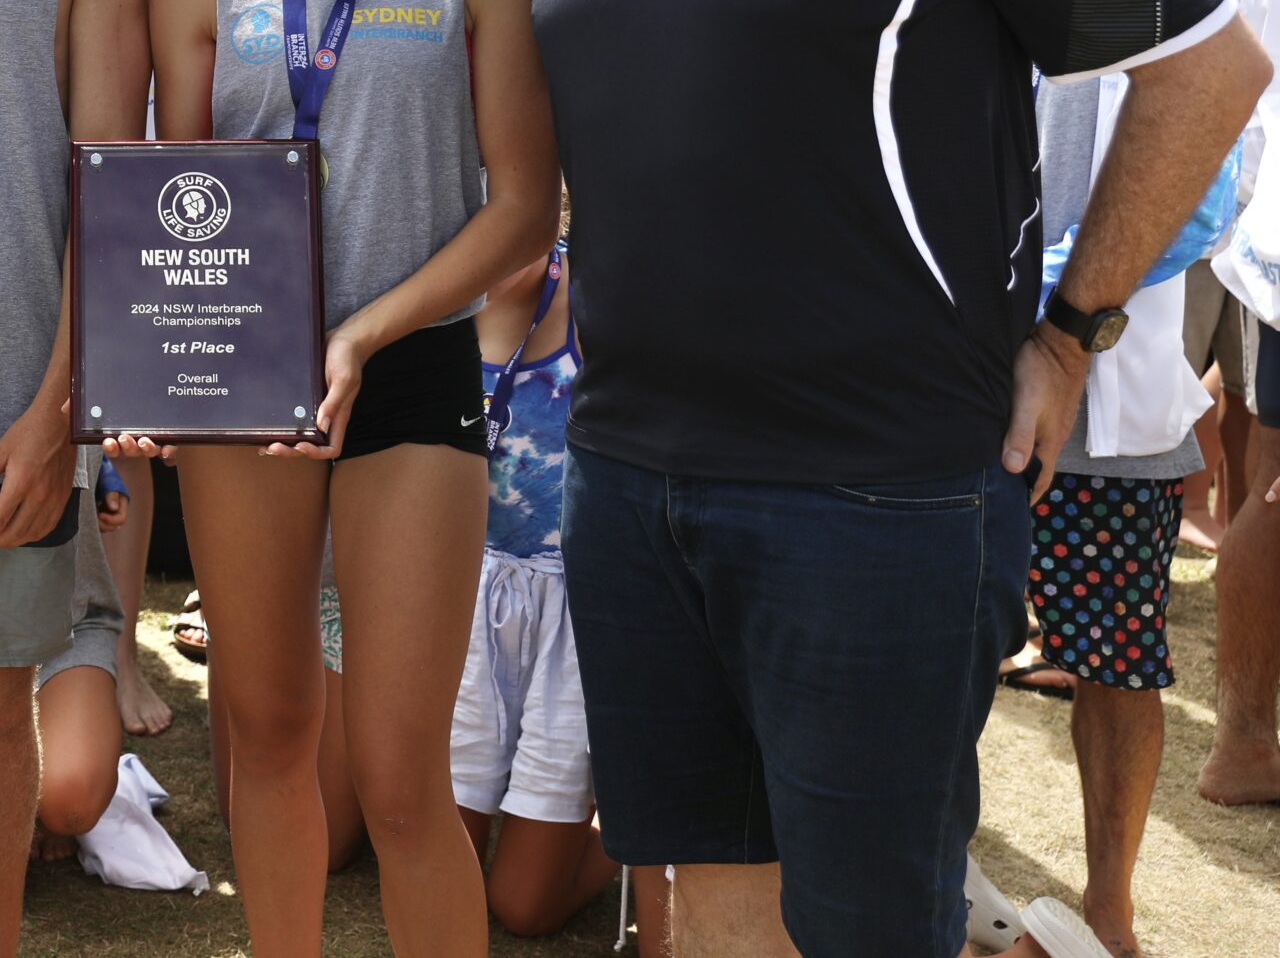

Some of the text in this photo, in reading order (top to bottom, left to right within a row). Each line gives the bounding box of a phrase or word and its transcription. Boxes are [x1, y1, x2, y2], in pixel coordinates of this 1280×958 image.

[352, 7, 443, 26] SYDNEY
[330, 35, 339, 50] NEW
[335, 19, 345, 38] SOUTH
[290, 34, 301, 67] BRANCH
[297, 33, 309, 69] INTER24
[176, 176, 214, 189] SURF
[162, 207, 228, 238] LIFE SAVING
[141, 248, 250, 266] NEW SOUTH
[163, 269, 228, 286] WALES
[131, 303, 263, 314] 2024 NSW Interbranch
[152, 315, 241, 327] Championships
[161, 341, 235, 354] 1st Place
[177, 373, 219, 384] Overall
[167, 385, 229, 396] Pointscore
